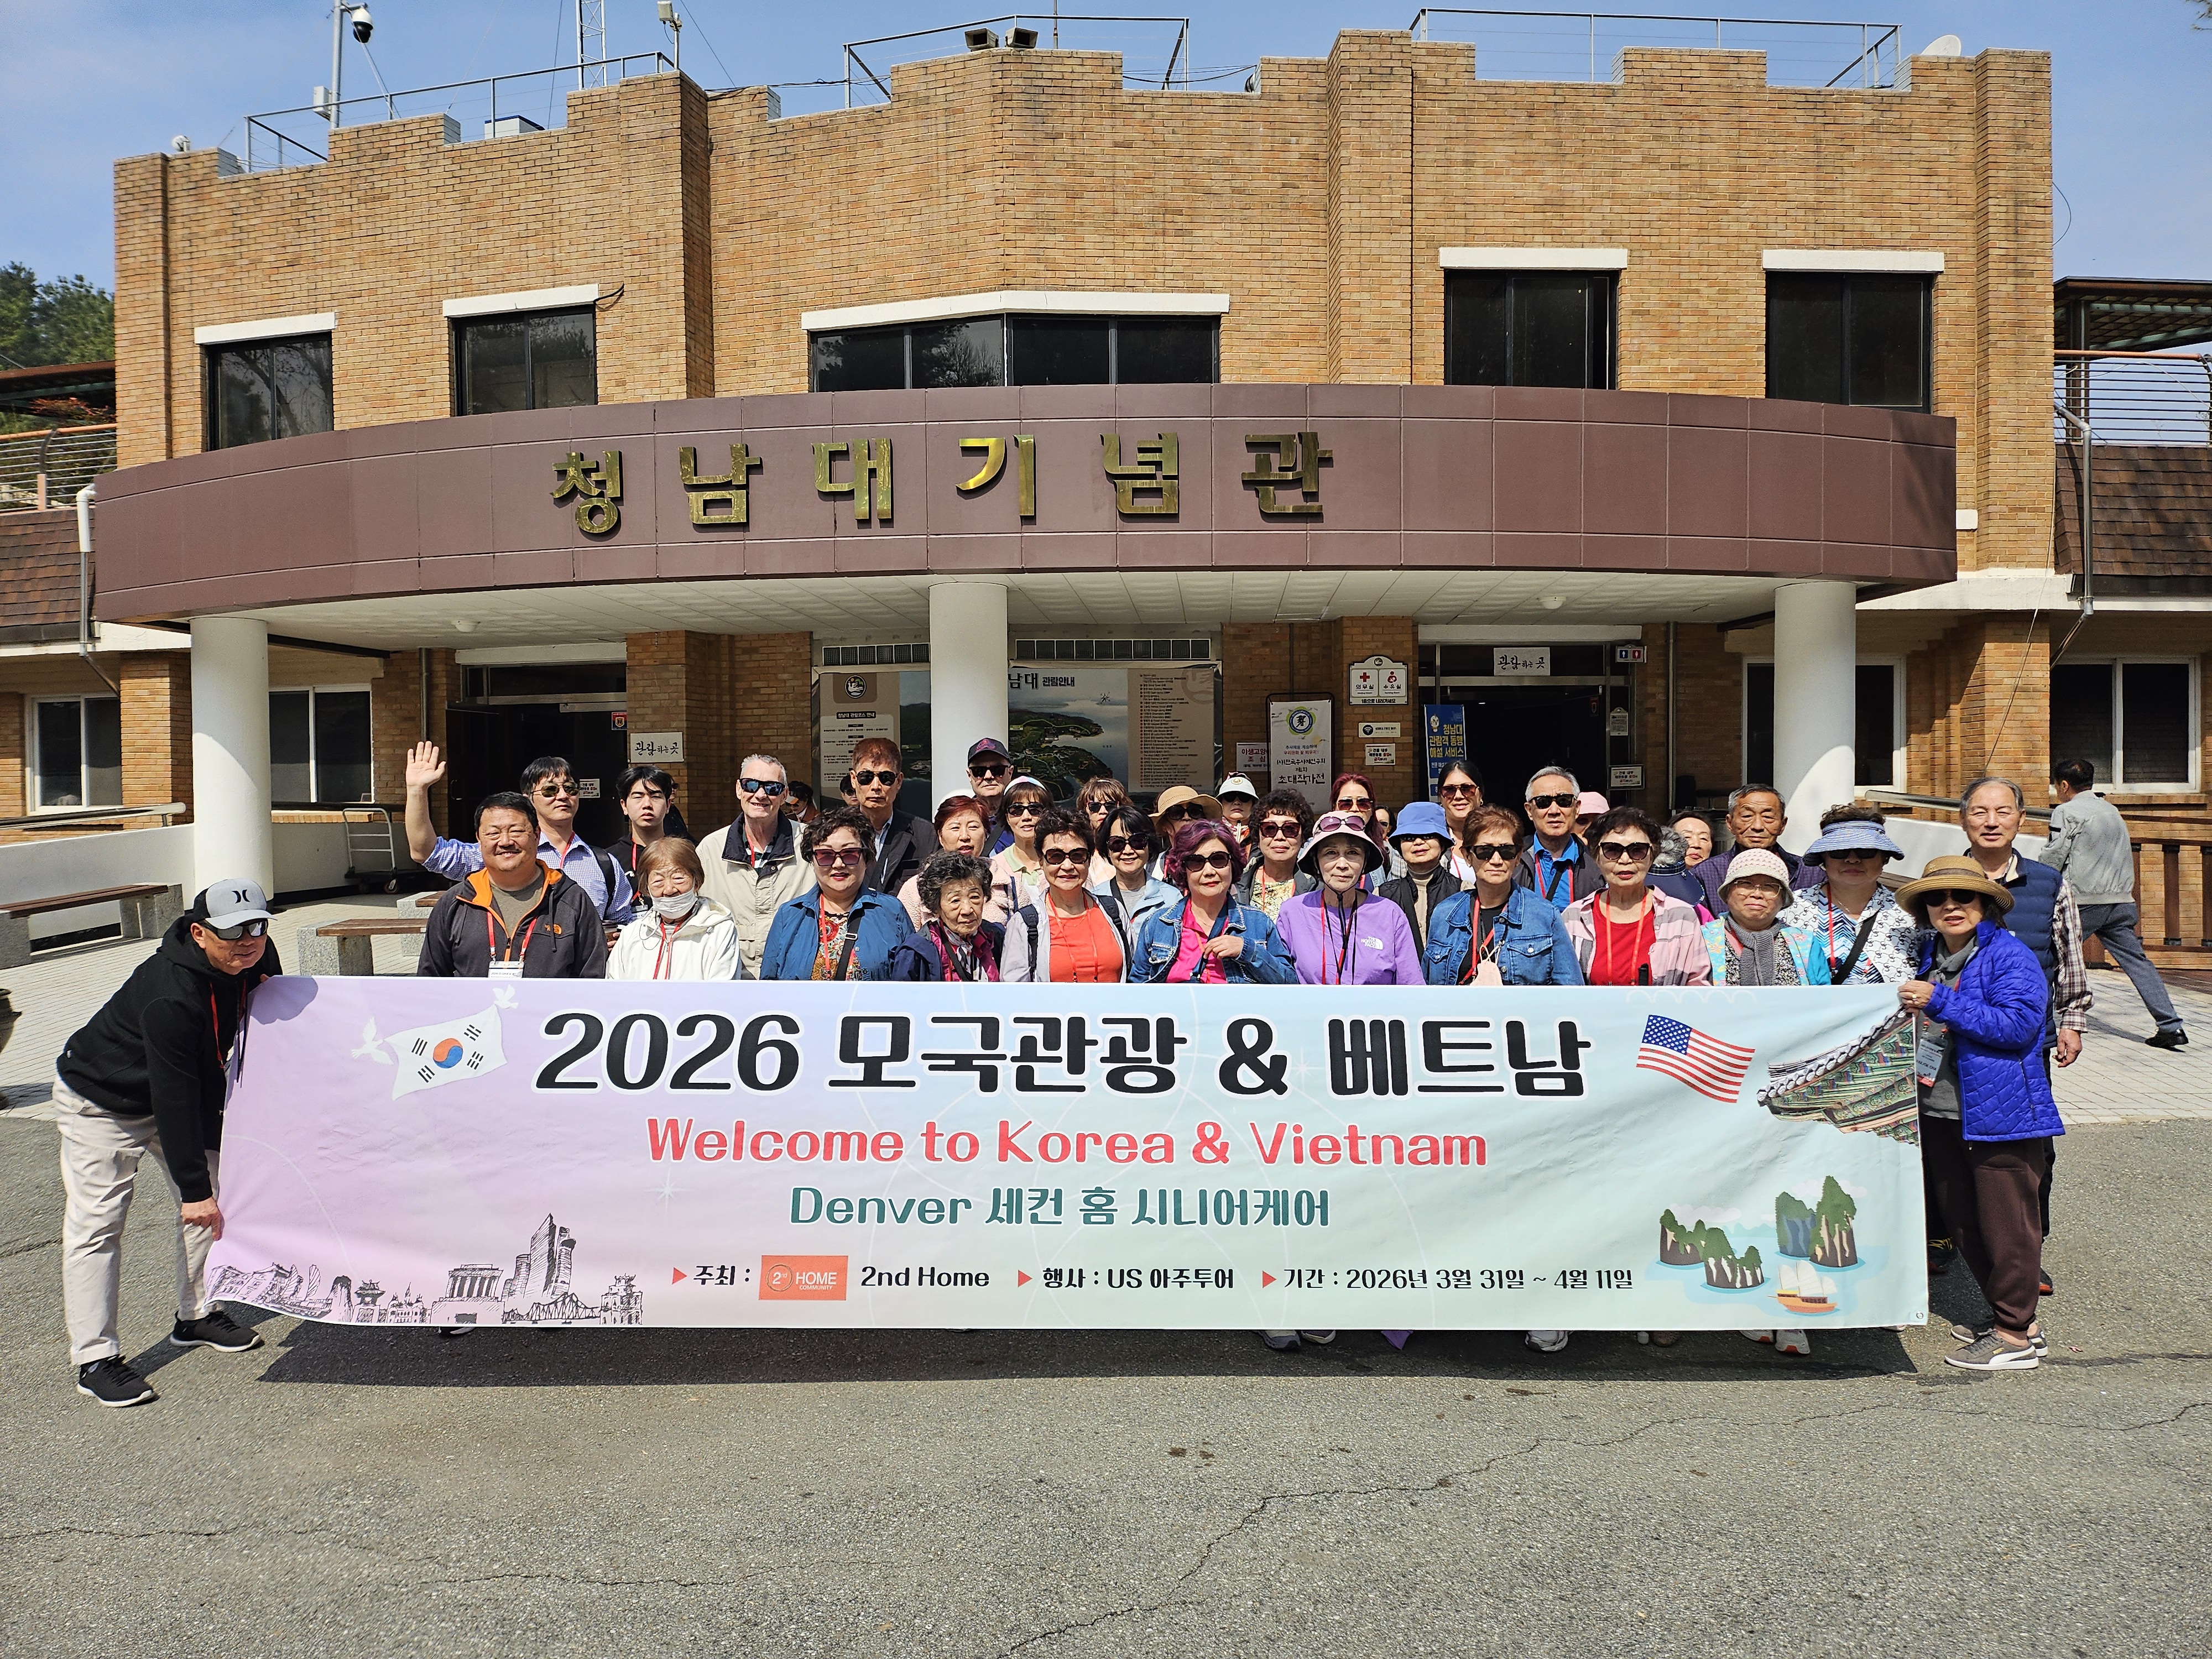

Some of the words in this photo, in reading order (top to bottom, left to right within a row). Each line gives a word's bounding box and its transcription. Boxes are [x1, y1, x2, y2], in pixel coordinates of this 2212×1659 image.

[1042, 676, 1075, 686] 관람안내
[1443, 724, 1463, 735] 청남대
[1429, 735, 1449, 747] 관람객
[1451, 735, 1463, 746] 동행
[1430, 747, 1443, 758] 해설
[1445, 747, 1464, 758] 서비스
[1278, 773, 1326, 784] 초대작가전
[535, 1012, 801, 1092] 2026
[828, 1015, 1188, 1094] 모국관광
[1218, 1018, 1288, 1096] &
[1327, 1018, 1592, 1097] 베트남
[648, 1118, 904, 1162] Welcome
[920, 1121, 980, 1162] to
[998, 1120, 1174, 1164] Korea
[1192, 1122, 1229, 1164] &
[1250, 1123, 1486, 1166] Vietnam
[791, 1187, 972, 1224] Denver
[985, 1188, 1062, 1224] 세컨
[1079, 1186, 1118, 1225] 홈
[1131, 1189, 1328, 1226] 시니어케어
[693, 1265, 735, 1286] 주최
[861, 1266, 910, 1286] 2nd
[918, 1266, 989, 1287] Home
[796, 1272, 837, 1285] HOME
[1042, 1267, 1086, 1288] 행사
[1108, 1269, 1142, 1288] US
[1150, 1269, 1233, 1288] 아주투어
[1284, 1269, 1326, 1288] 기간
[1346, 1269, 1428, 1289] 2026년
[1436, 1269, 1472, 1289] 3월
[1480, 1269, 1525, 1289] 31일
[1554, 1270, 1588, 1289] 4월
[1595, 1270, 1633, 1289] 11일
